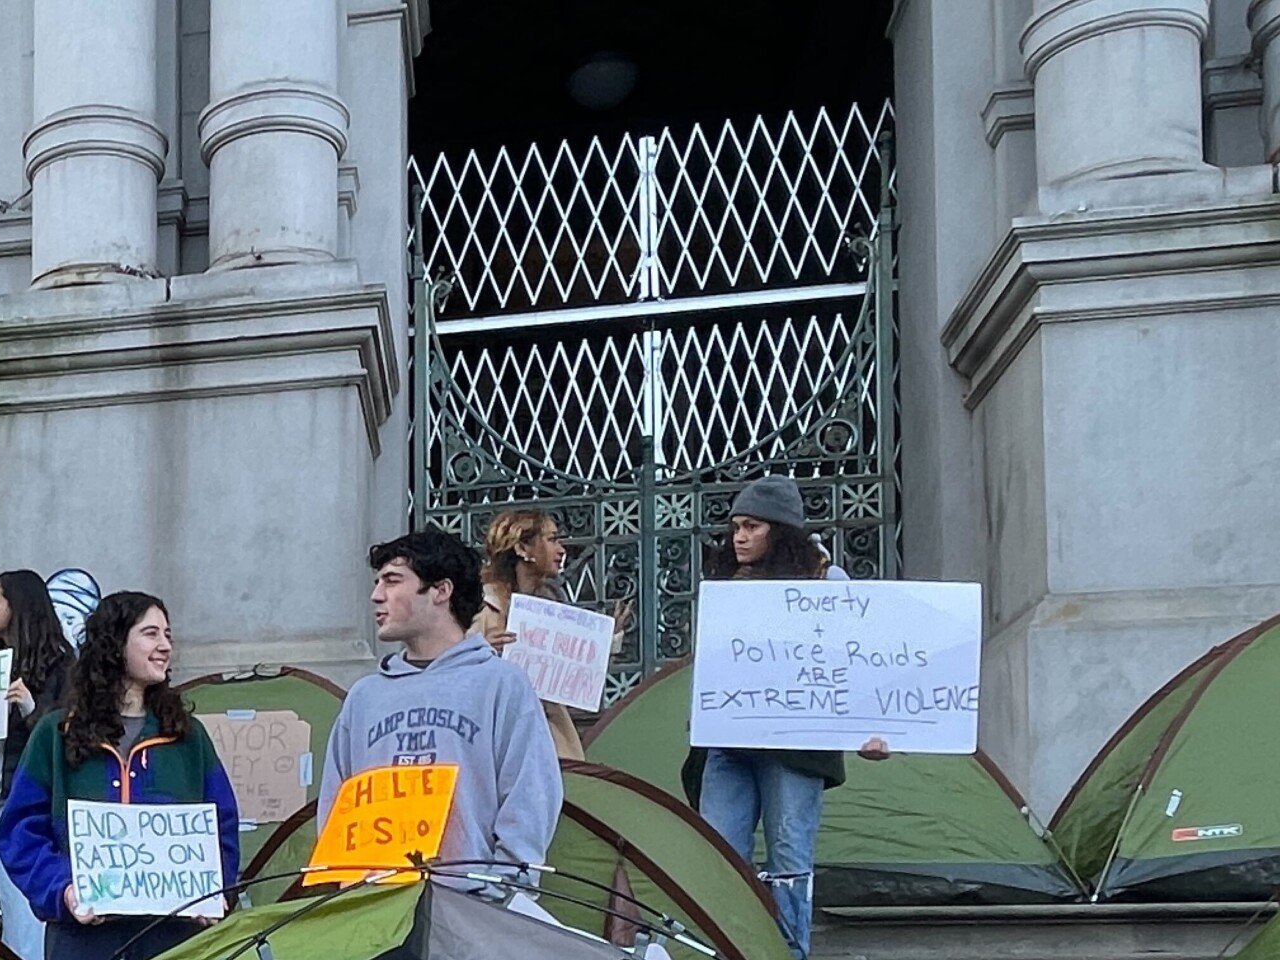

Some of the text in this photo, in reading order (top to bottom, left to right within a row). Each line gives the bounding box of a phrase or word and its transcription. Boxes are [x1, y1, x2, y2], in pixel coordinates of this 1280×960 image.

[785, 586, 870, 617] Poverty
[731, 638, 928, 668] Police Raids
[797, 667, 847, 686] ARE
[700, 685, 979, 715] EXTREME VIOLENCE
[213, 723, 289, 753] AYOR
[367, 707, 481, 748] CAMP CROSLEY
[396, 730, 436, 751] YMCA
[72, 809, 216, 838] END POLICE
[74, 842, 205, 870] RAIDS ON
[76, 870, 221, 902] ENCAMPMENTS
